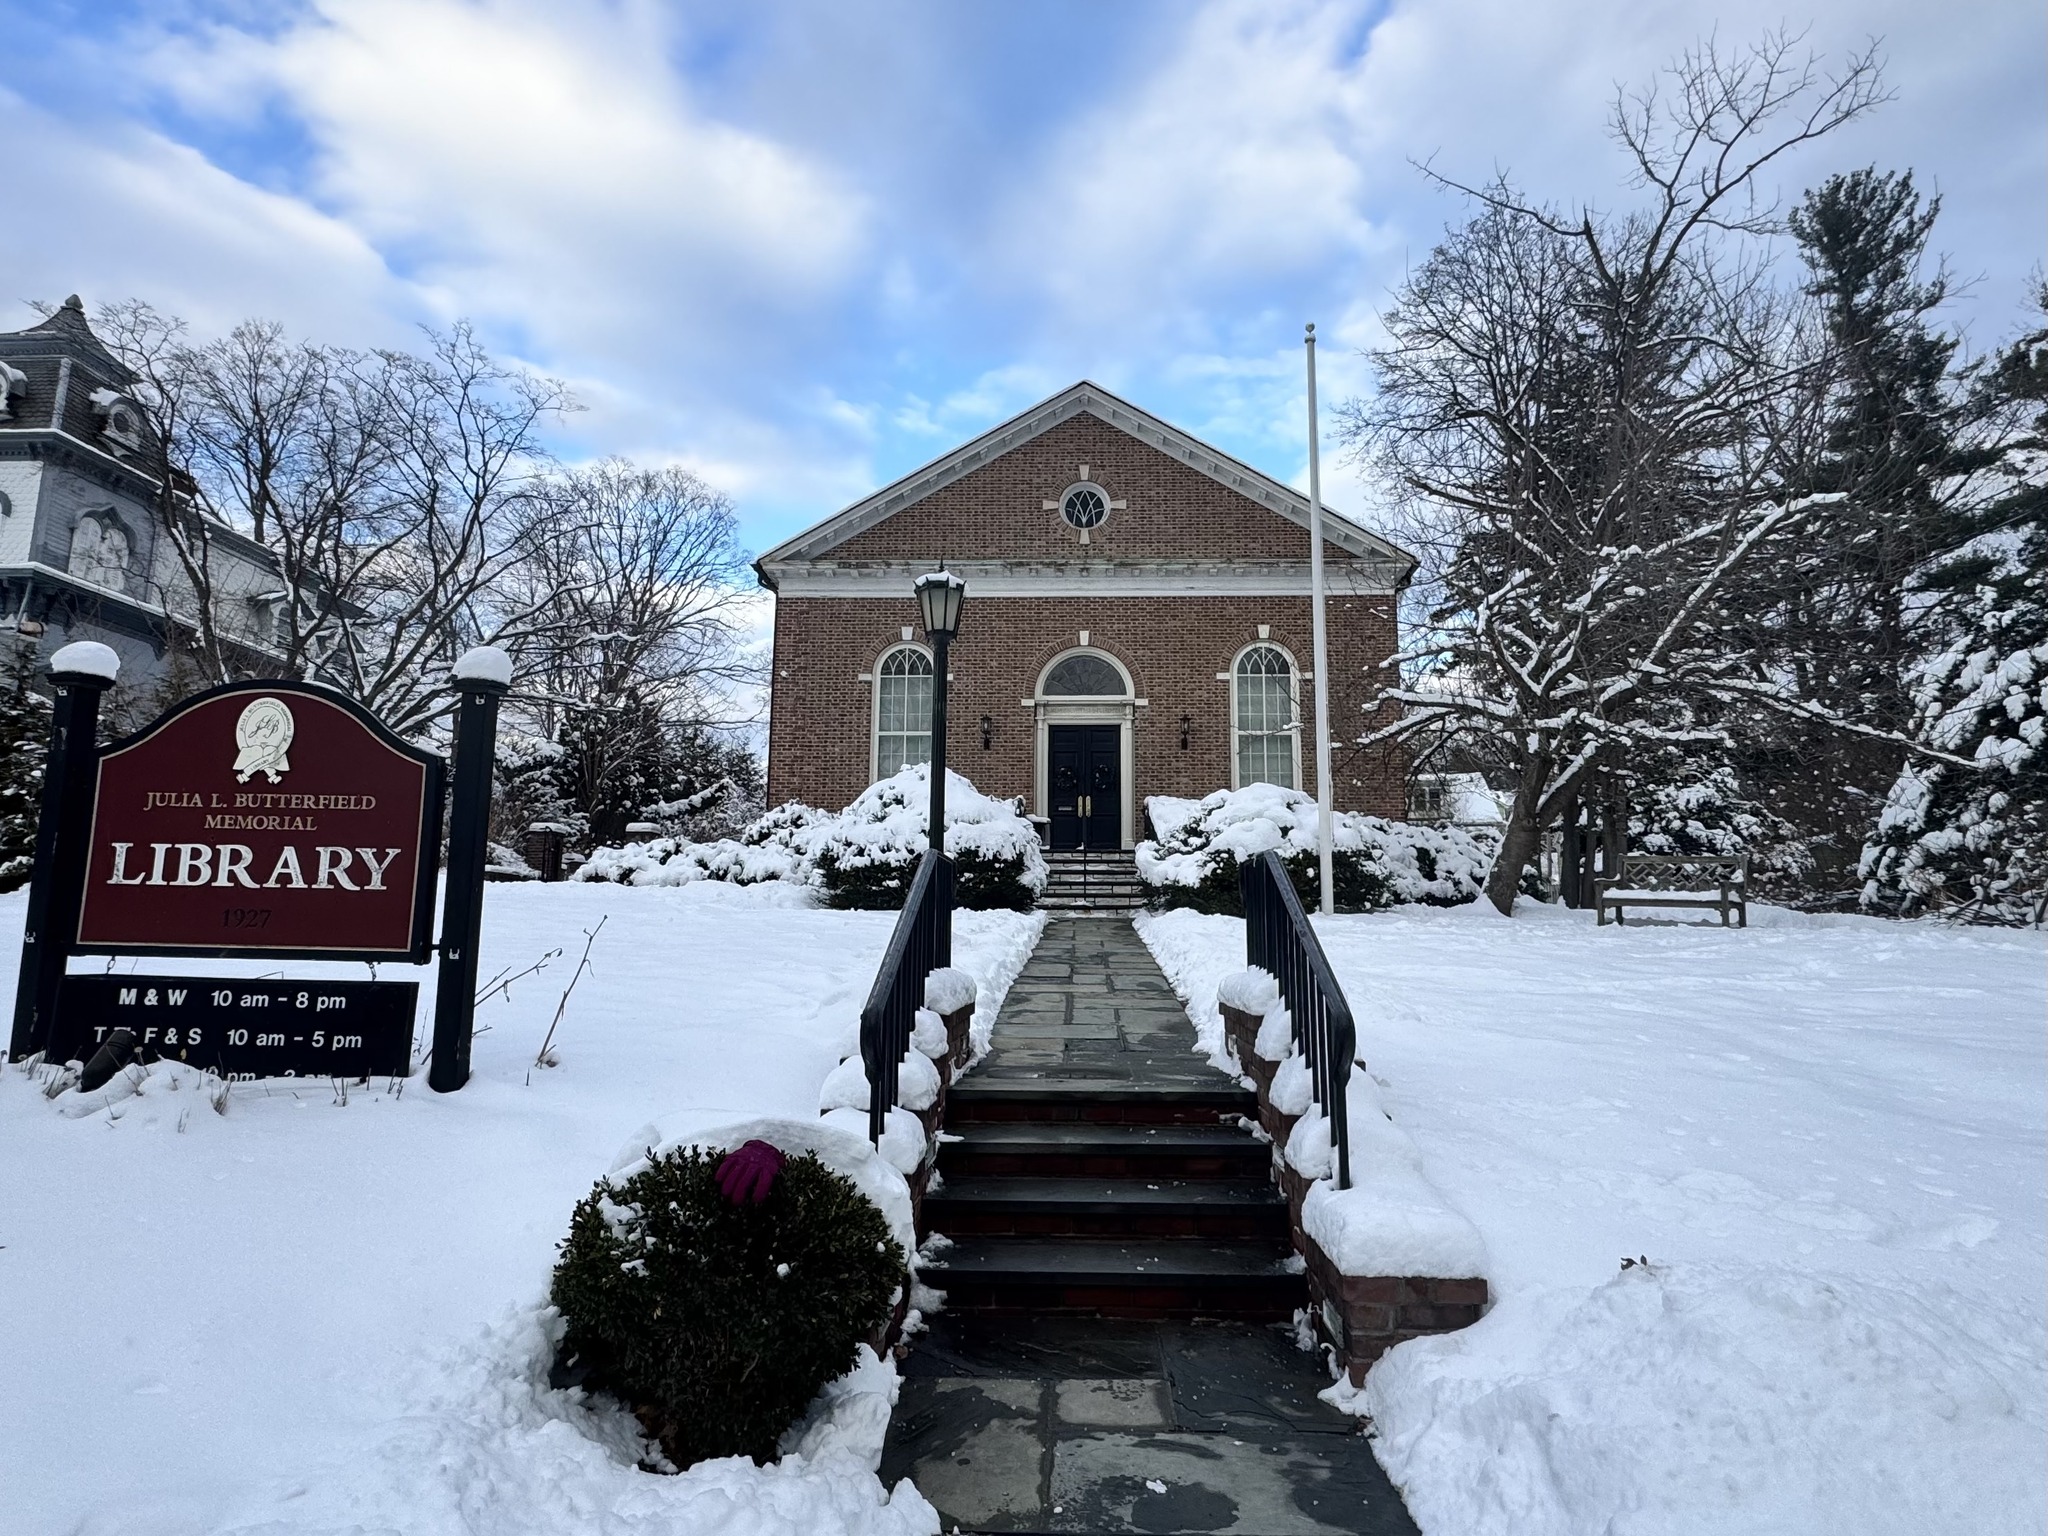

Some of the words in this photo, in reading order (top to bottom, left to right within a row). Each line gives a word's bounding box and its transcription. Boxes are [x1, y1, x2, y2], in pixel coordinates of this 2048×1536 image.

[143, 792, 204, 811] JULIA
[210, 793, 228, 808] L.
[233, 793, 377, 810] BUTTERFIELD
[204, 814, 318, 831] MEMORIAL
[106, 842, 402, 891] LIBRARY
[222, 907, 273, 929] 1927
[118, 988, 138, 1006] M
[144, 988, 159, 1006] &
[167, 989, 188, 1006] W
[210, 990, 233, 1007] 10
[239, 994, 270, 1008] am
[295, 991, 309, 1009] 8
[316, 996, 347, 1012] pm
[93, 1026, 108, 1043] T
[144, 1027, 159, 1044] F
[164, 1027, 179, 1045] &
[187, 1027, 202, 1045] S
[226, 1028, 249, 1046] 10
[255, 1033, 285, 1047] am
[311, 1030, 325, 1048] 5
[331, 1035, 362, 1051] pm
